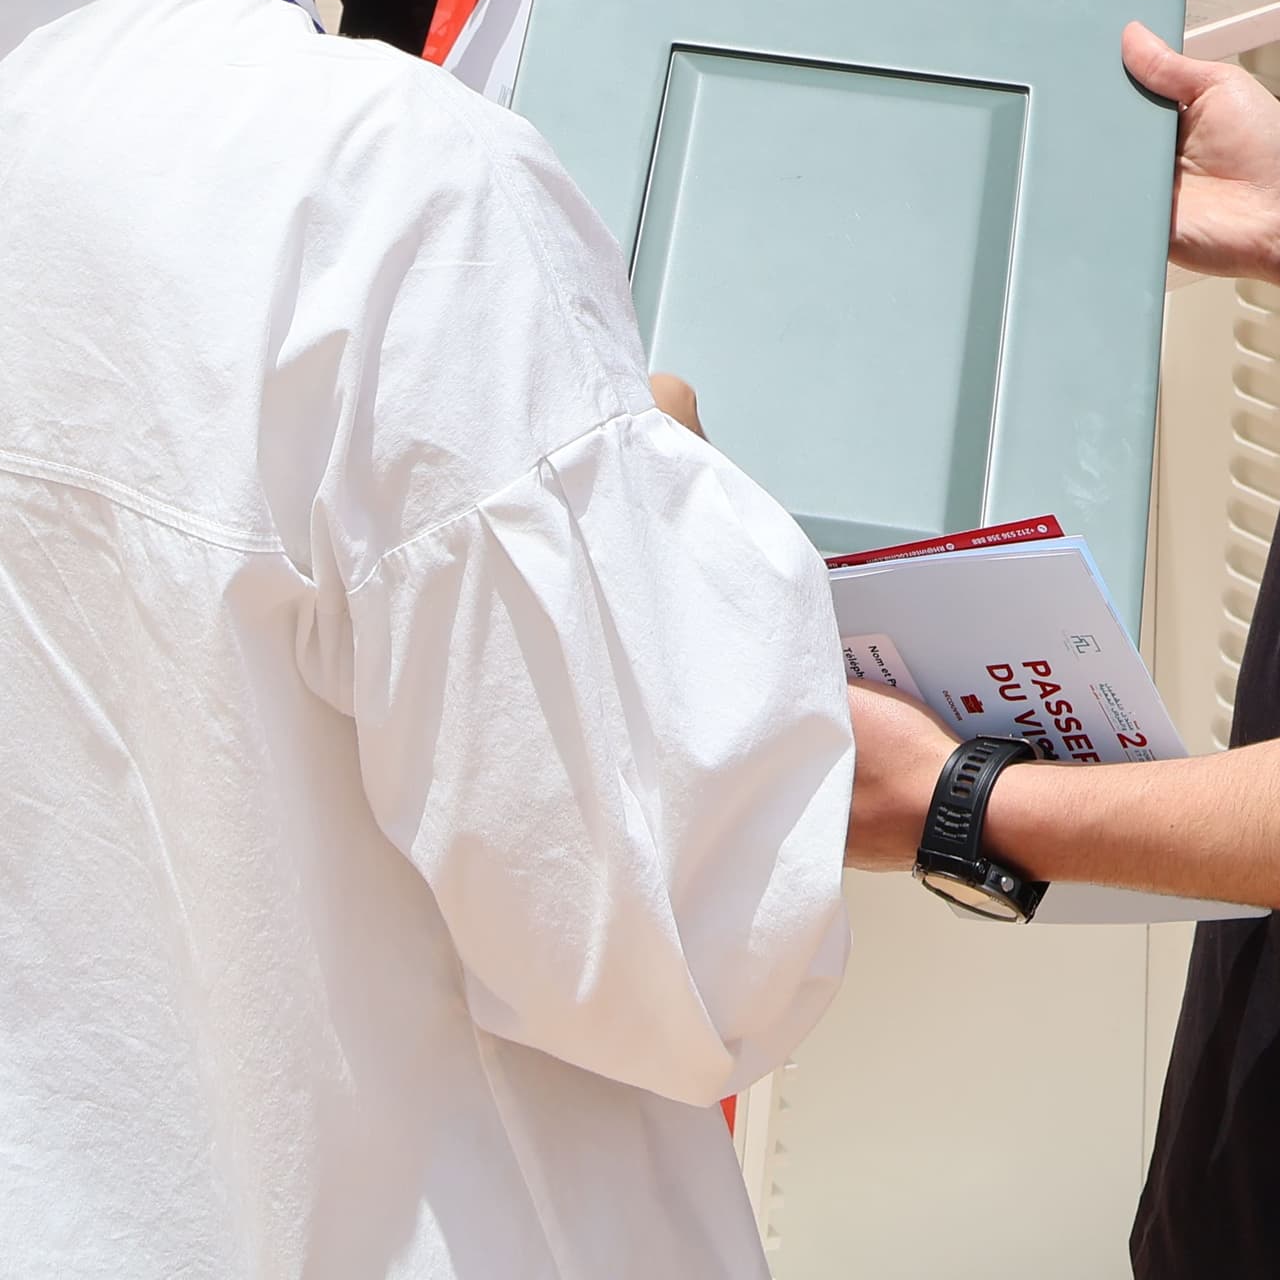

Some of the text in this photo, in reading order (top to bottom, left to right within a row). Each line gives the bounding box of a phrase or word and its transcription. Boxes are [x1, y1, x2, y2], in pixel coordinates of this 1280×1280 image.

[868, 644, 885, 667] Nom
[985, 663, 1028, 702] DU
[1116, 731, 1148, 749] 2
